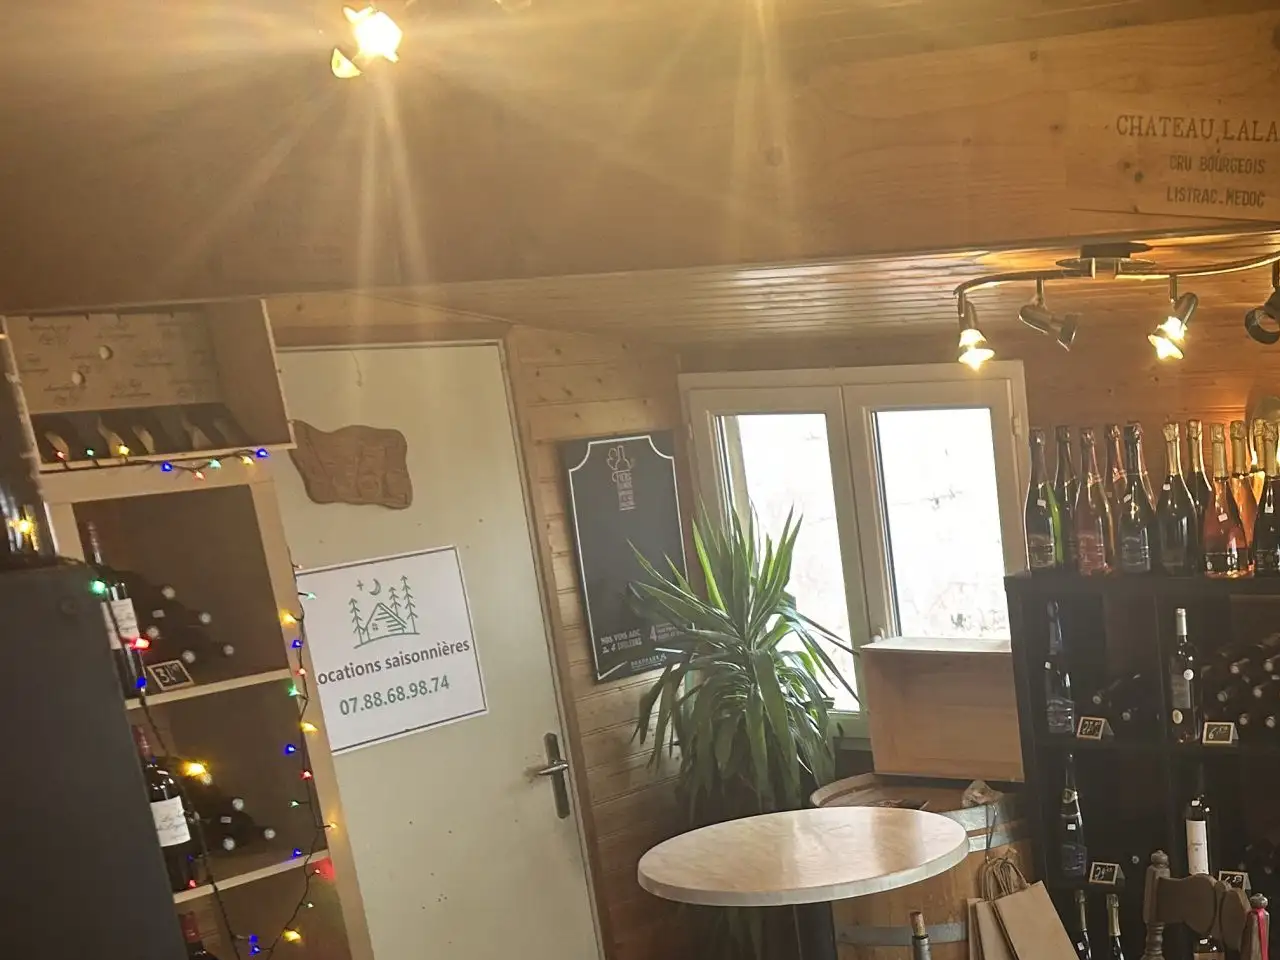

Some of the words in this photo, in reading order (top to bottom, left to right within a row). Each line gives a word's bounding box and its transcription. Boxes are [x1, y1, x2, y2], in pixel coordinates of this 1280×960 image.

[1116, 114, 1215, 139] CHATEAU
[1169, 155, 1192, 171] CRU
[1200, 156, 1266, 175] BOURGEOIS
[317, 660, 382, 686] ocations
[385, 639, 471, 670] saisonnières
[339, 674, 450, 716] 07.88.68.98.74
